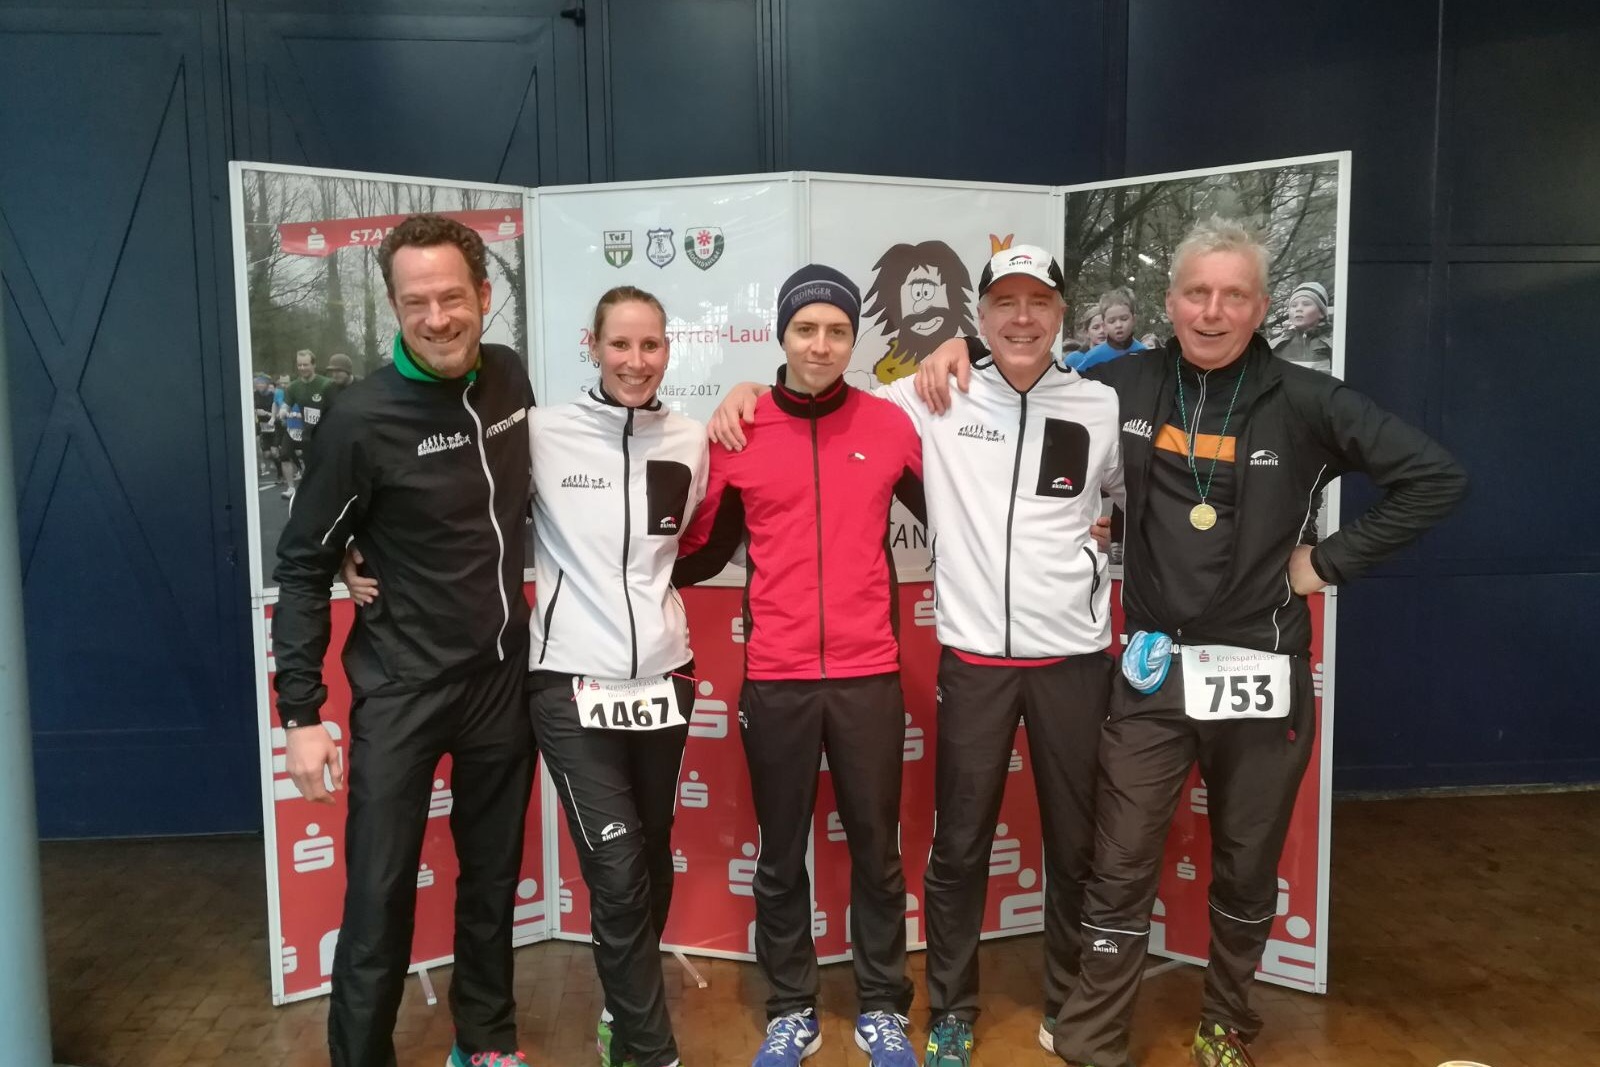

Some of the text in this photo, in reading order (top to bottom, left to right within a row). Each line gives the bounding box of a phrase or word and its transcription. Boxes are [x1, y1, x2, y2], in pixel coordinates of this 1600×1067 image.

[658, 384, 721, 396] März 2017
[1250, 458, 1279, 466] skinfit
[1205, 674, 1274, 713] 753
[589, 696, 670, 728] 1467
[601, 827, 628, 842] skinfit
